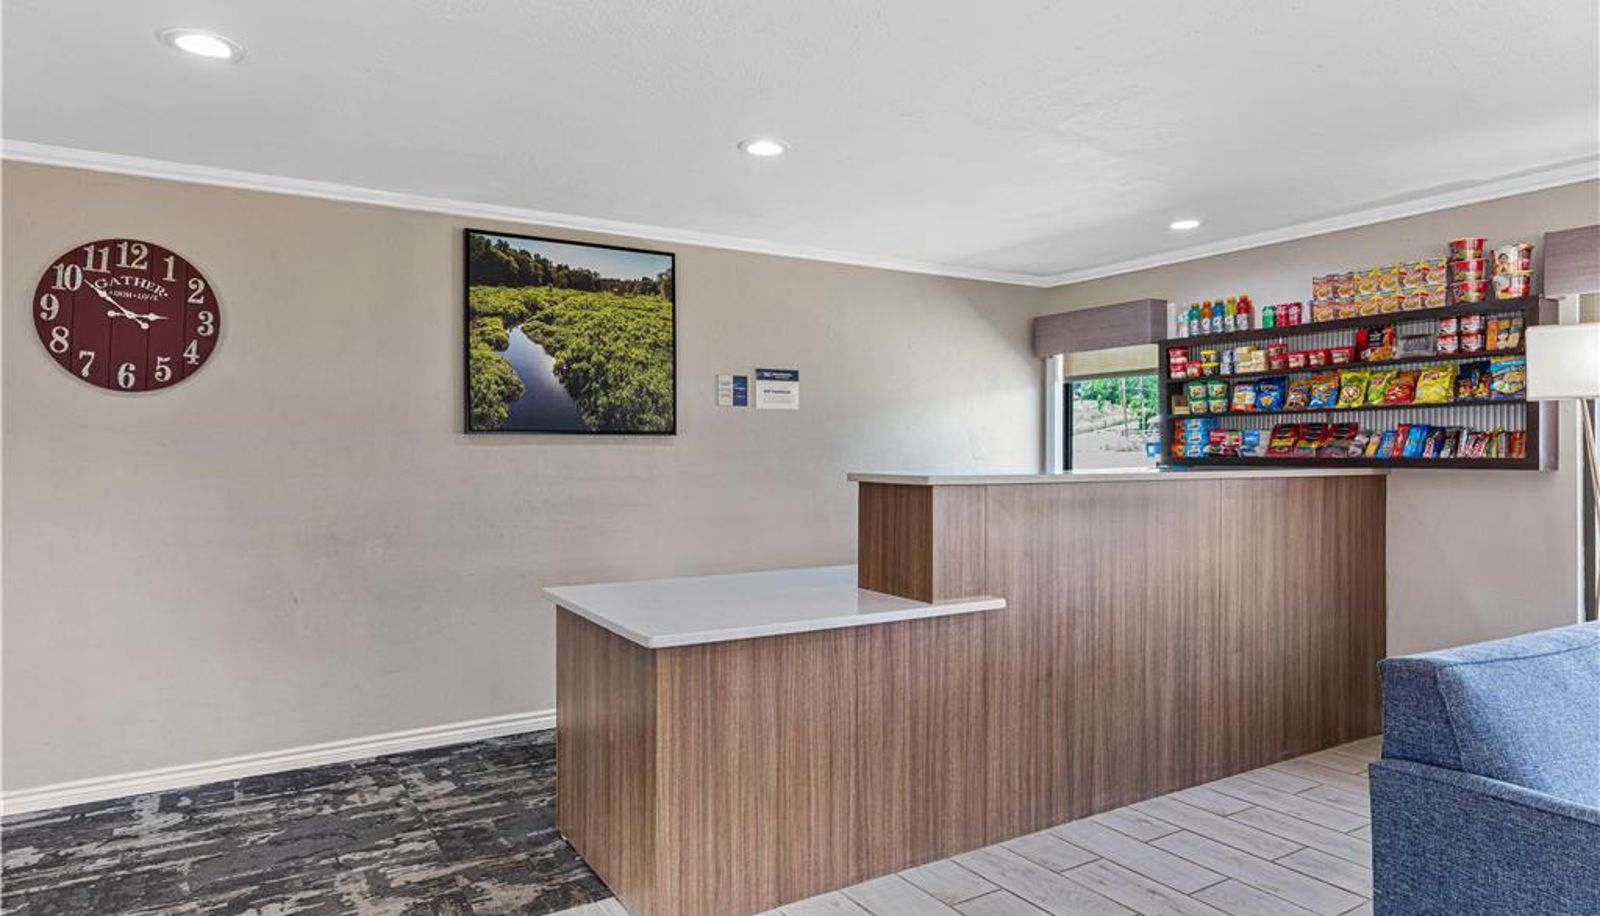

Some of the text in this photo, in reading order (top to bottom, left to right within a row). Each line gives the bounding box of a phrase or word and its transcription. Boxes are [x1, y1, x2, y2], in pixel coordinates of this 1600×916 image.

[83, 245, 111, 273] 11
[116, 241, 148, 270] 12
[162, 255, 176, 282] 1
[51, 263, 83, 291] 10
[95, 276, 165, 296] GATHER
[187, 277, 206, 304] 2
[39, 293, 60, 321] 9
[197, 310, 214, 336] 3
[50, 326, 70, 353] 8
[183, 339, 200, 365] 4
[79, 350, 95, 377] 7
[117, 362, 136, 388] 6
[154, 356, 172, 382] 5
